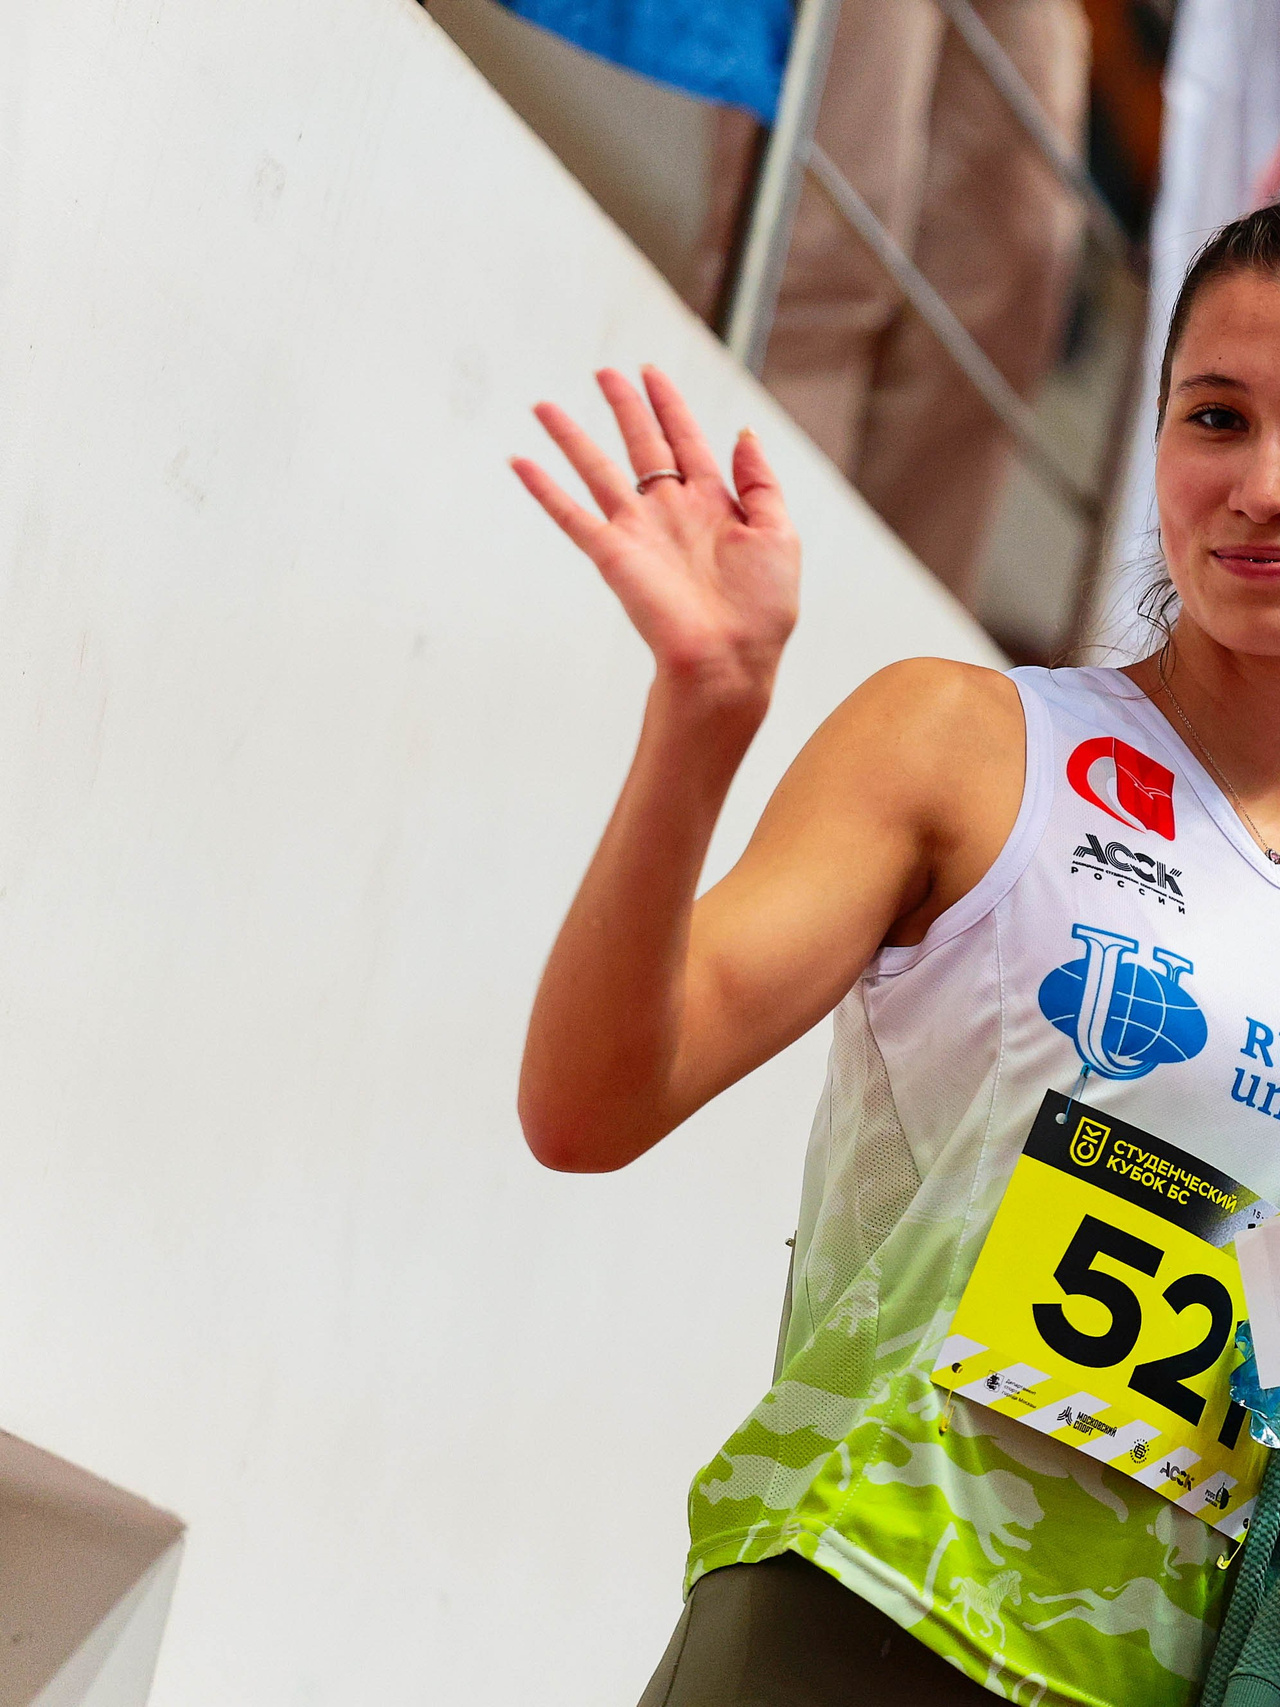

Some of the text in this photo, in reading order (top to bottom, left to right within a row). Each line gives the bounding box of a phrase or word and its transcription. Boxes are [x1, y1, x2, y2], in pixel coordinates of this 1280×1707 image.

[1073, 833, 1184, 897] АССК
[1071, 866, 1186, 915] РОССИИ
[1106, 1155, 1191, 1206] КУБОК БС
[1113, 1140, 1238, 1213] СТУДЕНЧЕСКИЙ
[1073, 1420, 1095, 1437] СПОРТ
[1076, 1411, 1118, 1438] МОСКОВСКИЙ
